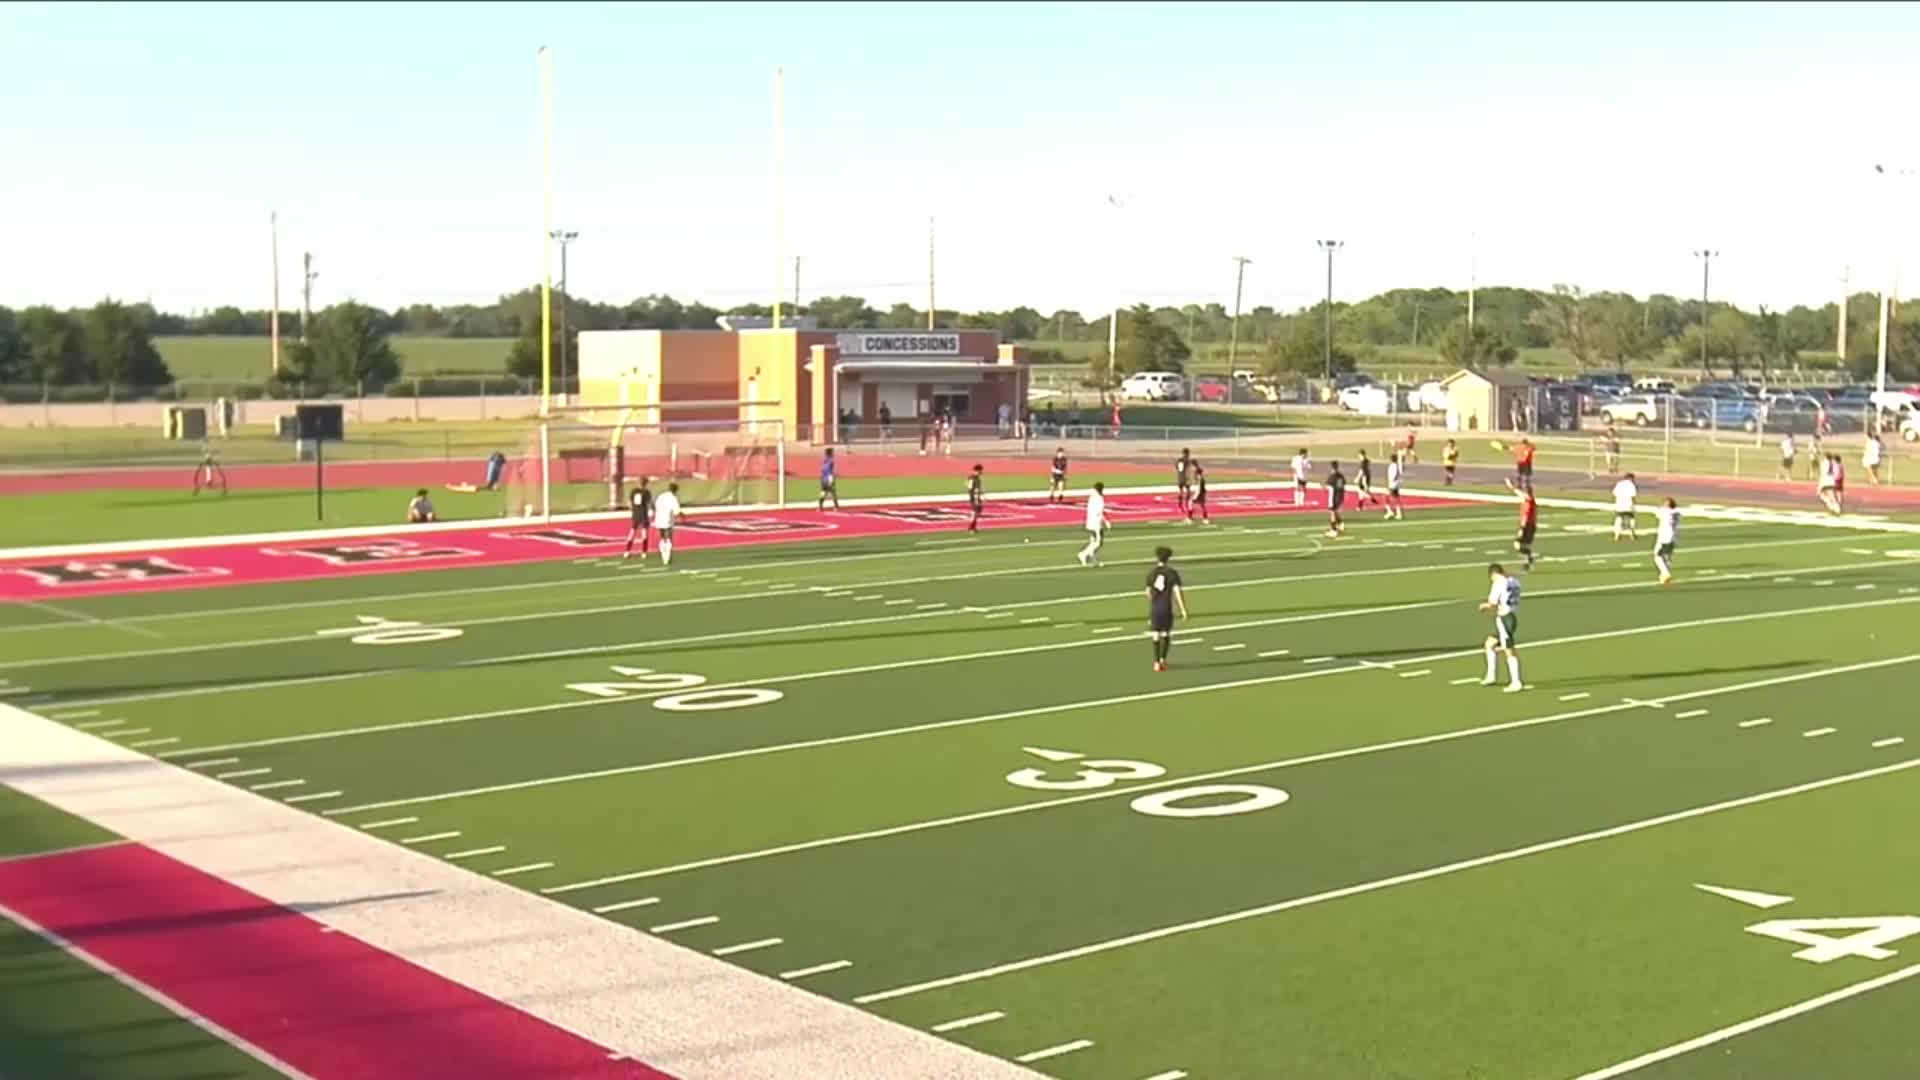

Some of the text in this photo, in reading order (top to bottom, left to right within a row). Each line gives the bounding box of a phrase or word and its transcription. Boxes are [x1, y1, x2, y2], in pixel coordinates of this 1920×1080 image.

[866, 337, 957, 351] CONCESSIONS
[1153, 574, 1166, 591] 4
[316, 621, 464, 644] 10
[564, 673, 784, 711] 20
[1006, 760, 1290, 817] 30
